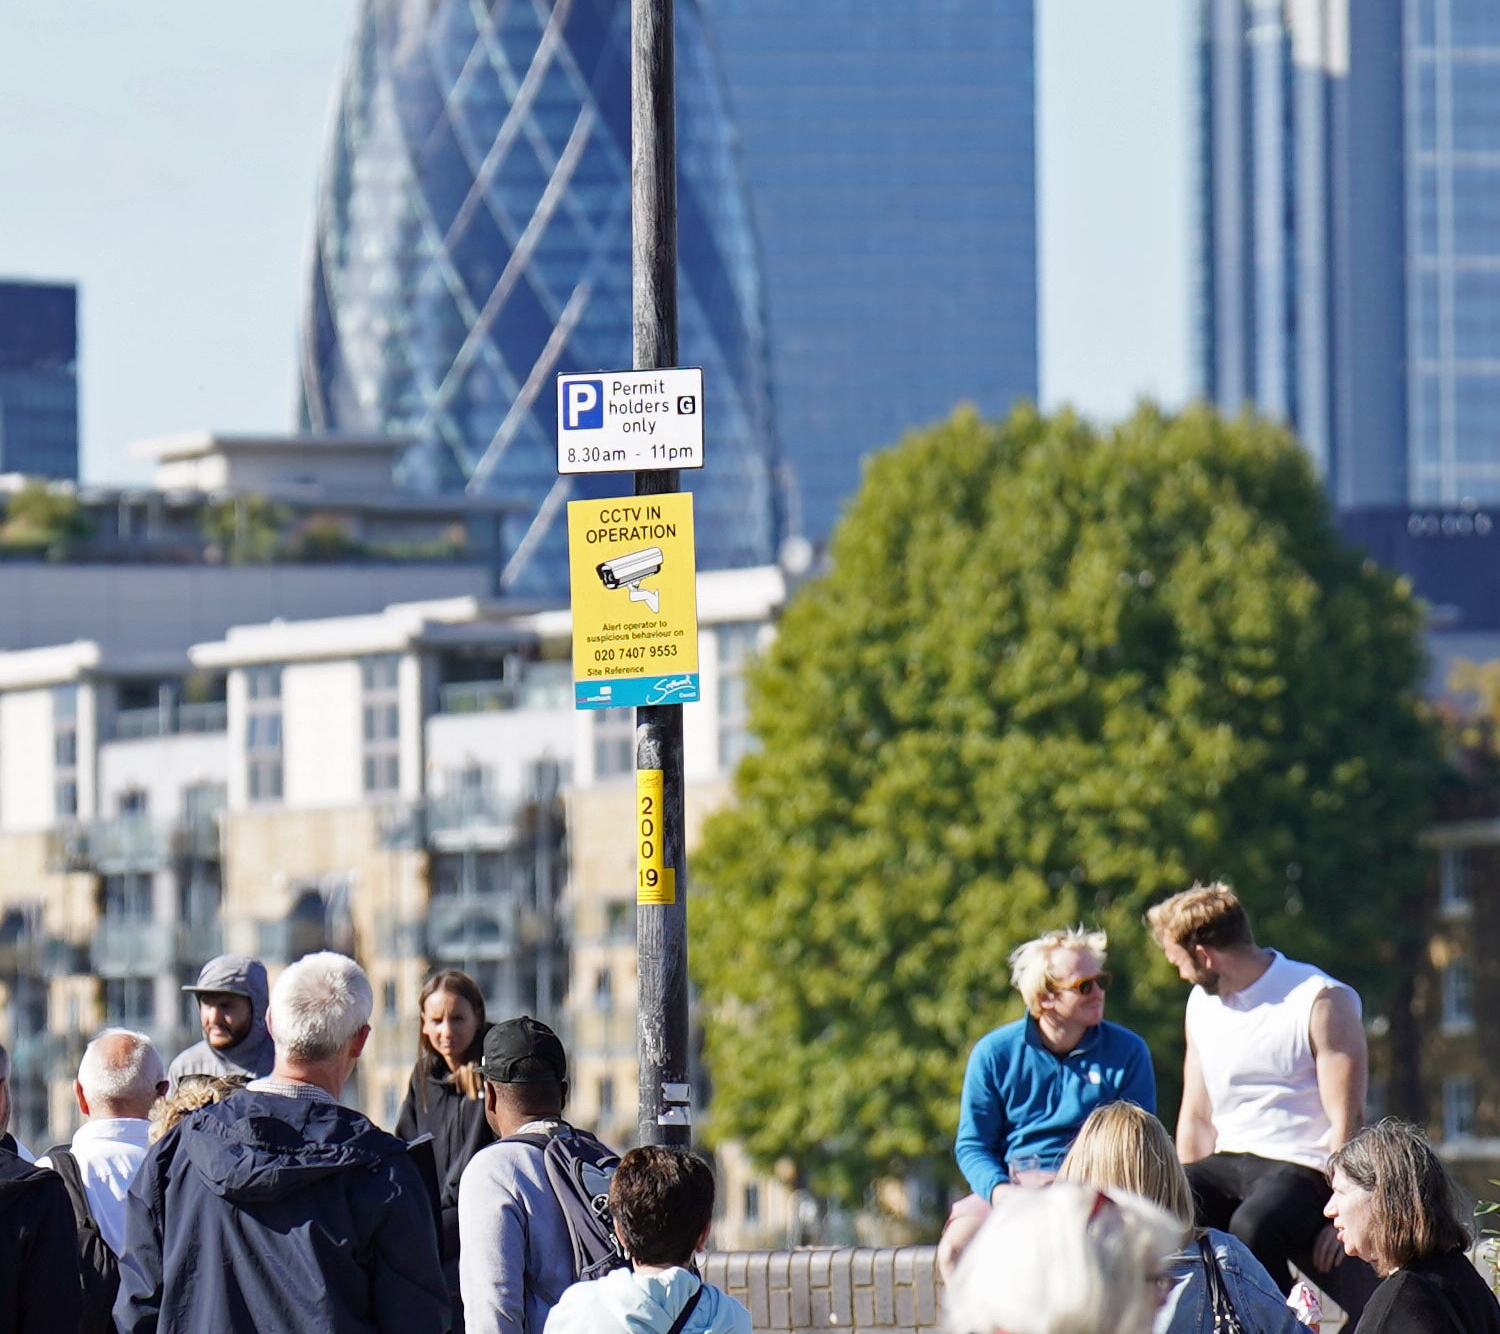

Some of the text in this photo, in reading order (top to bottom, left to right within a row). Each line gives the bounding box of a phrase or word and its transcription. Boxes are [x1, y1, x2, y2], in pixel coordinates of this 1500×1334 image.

[612, 379, 665, 396] Permit
[569, 383, 597, 427] P
[609, 400, 670, 415] holders
[679, 397, 693, 414] G
[622, 417, 656, 435] only
[567, 447, 626, 463] 8.30am
[650, 444, 693, 462] 11pm
[600, 505, 661, 524] CCTV IN
[586, 523, 676, 544] OPERATION
[602, 620, 668, 632] Alert operator to
[586, 629, 684, 643] suspicious behaviour on
[594, 644, 678, 662] 020 7407 9553
[587, 665, 645, 677] Site Reference
[639, 868, 659, 887] 19
